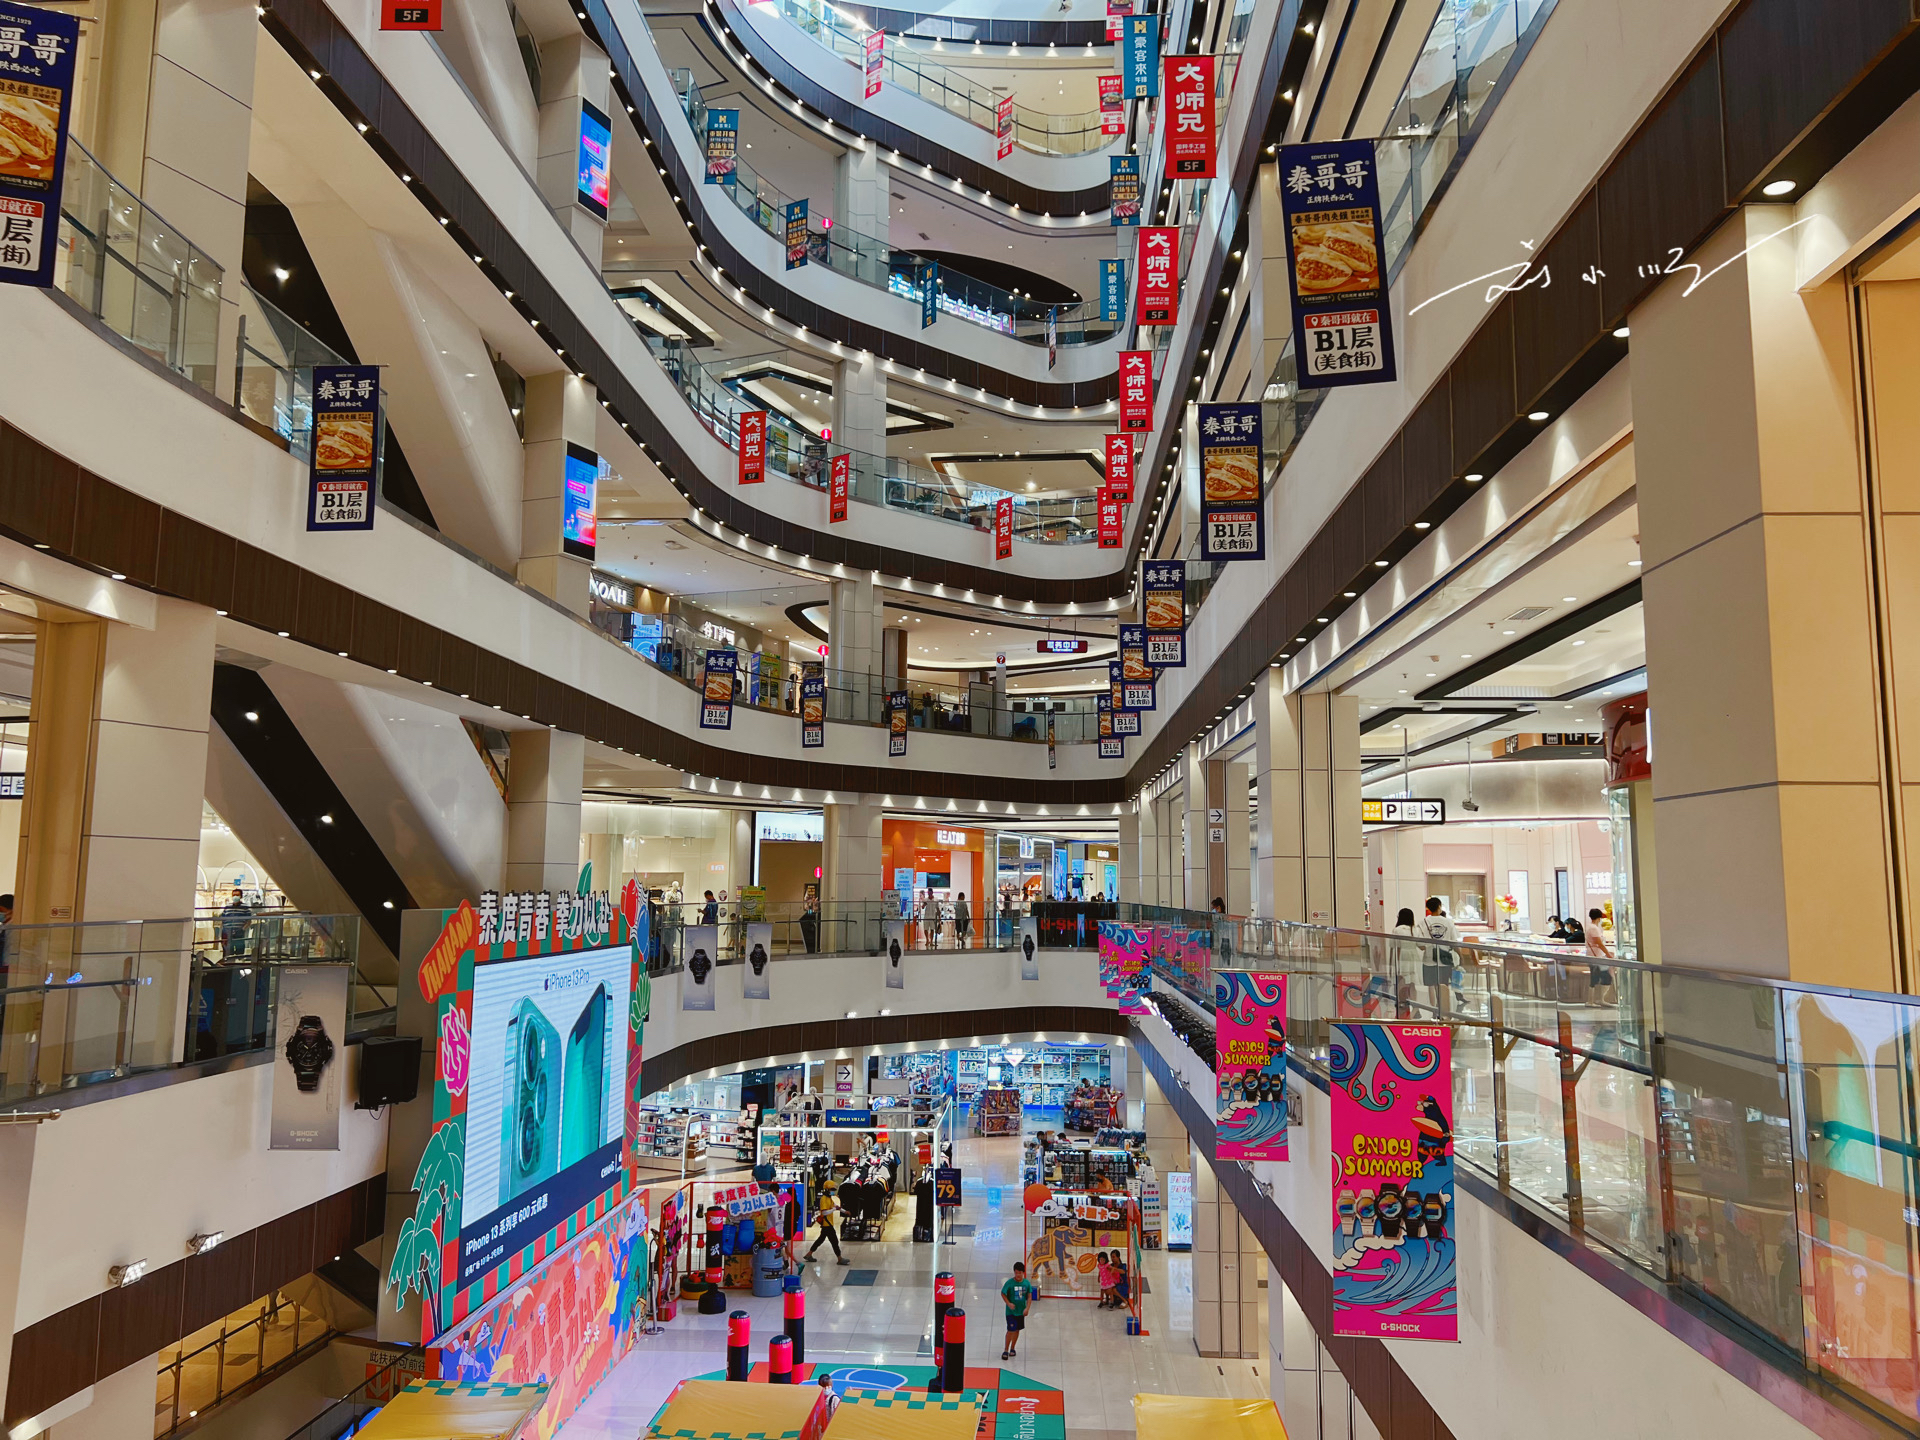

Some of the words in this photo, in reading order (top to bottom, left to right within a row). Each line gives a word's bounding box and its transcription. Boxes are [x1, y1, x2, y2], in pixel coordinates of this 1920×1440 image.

[403, 11, 421, 21] 5F
[1184, 162, 1199, 171] 5F
[1151, 311, 1163, 319] 5F
[1313, 326, 1374, 352] B1层
[321, 492, 362, 507] B1层
[320, 508, 361, 520] (美食街)
[1213, 523, 1253, 538] B1层
[1212, 539, 1253, 550] (美食街)
[589, 572, 627, 605] NOAH
[1151, 642, 1178, 652] B1层
[1387, 804, 1397, 818] P
[549, 973, 571, 990] iPhone
[580, 968, 590, 984] Pro
[1402, 1027, 1441, 1037] CASIO
[936, 1184, 956, 1199] 79
[465, 1232, 490, 1257] iPhone
[490, 1222, 499, 1240] 13
[519, 1207, 531, 1223] 600
[1380, 1322, 1421, 1333] G-SHOCK
